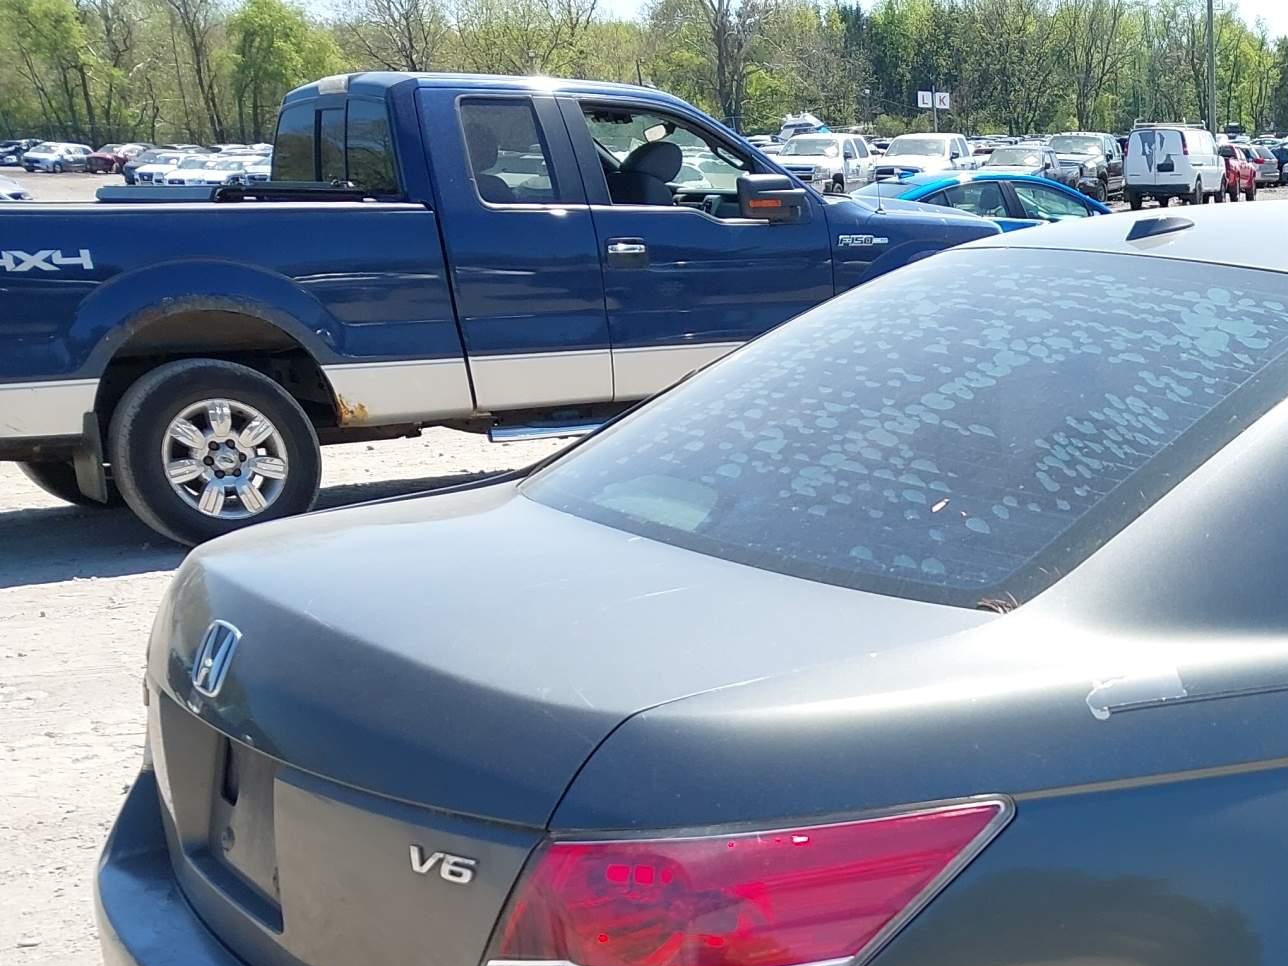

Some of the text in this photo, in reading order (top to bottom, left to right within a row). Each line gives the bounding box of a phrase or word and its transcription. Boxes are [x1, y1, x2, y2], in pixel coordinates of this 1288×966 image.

[921, 94, 929, 105] L
[938, 95, 946, 106] K
[408, 844, 478, 885] V6
